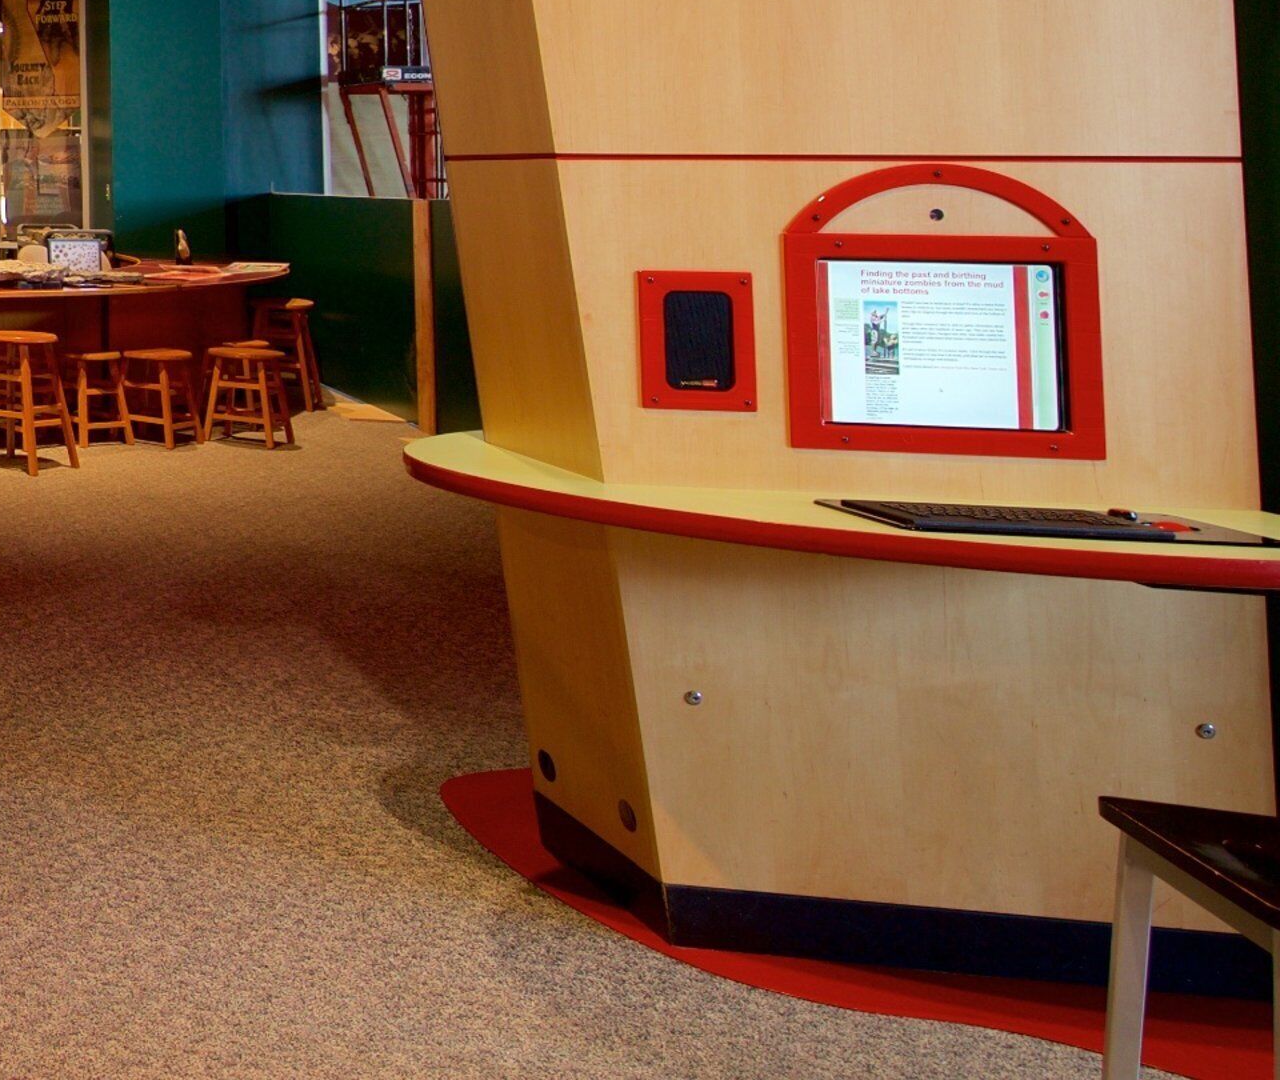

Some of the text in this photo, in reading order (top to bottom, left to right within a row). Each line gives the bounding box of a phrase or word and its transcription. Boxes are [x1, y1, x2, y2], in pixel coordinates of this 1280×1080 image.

[860, 269, 987, 281] Finding the past and birthing
[860, 278, 1005, 289] miniature zombies from the mud
